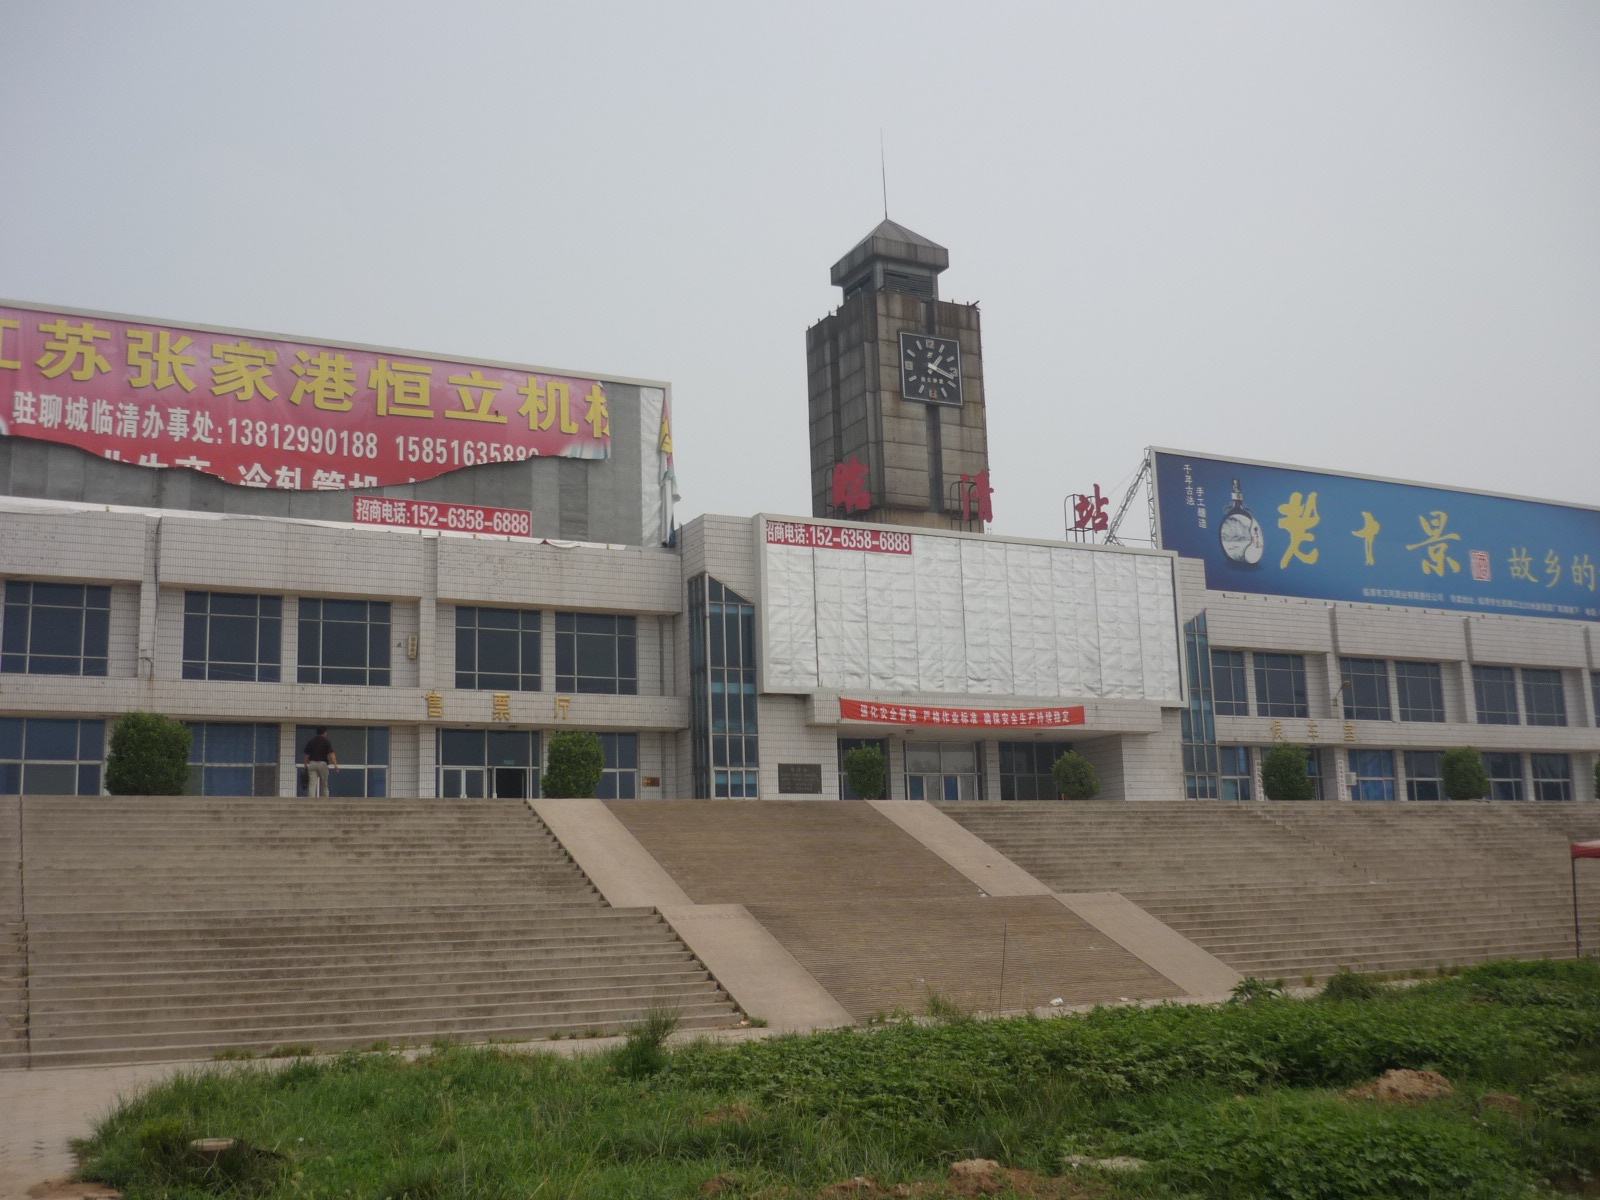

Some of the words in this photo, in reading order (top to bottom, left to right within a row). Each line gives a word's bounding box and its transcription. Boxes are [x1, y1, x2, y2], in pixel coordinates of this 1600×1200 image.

[0, 319, 610, 438] 苏张家港恒立机
[1507, 547, 1596, 592] 故乡的
[425, 690, 571, 721] 售票厅
